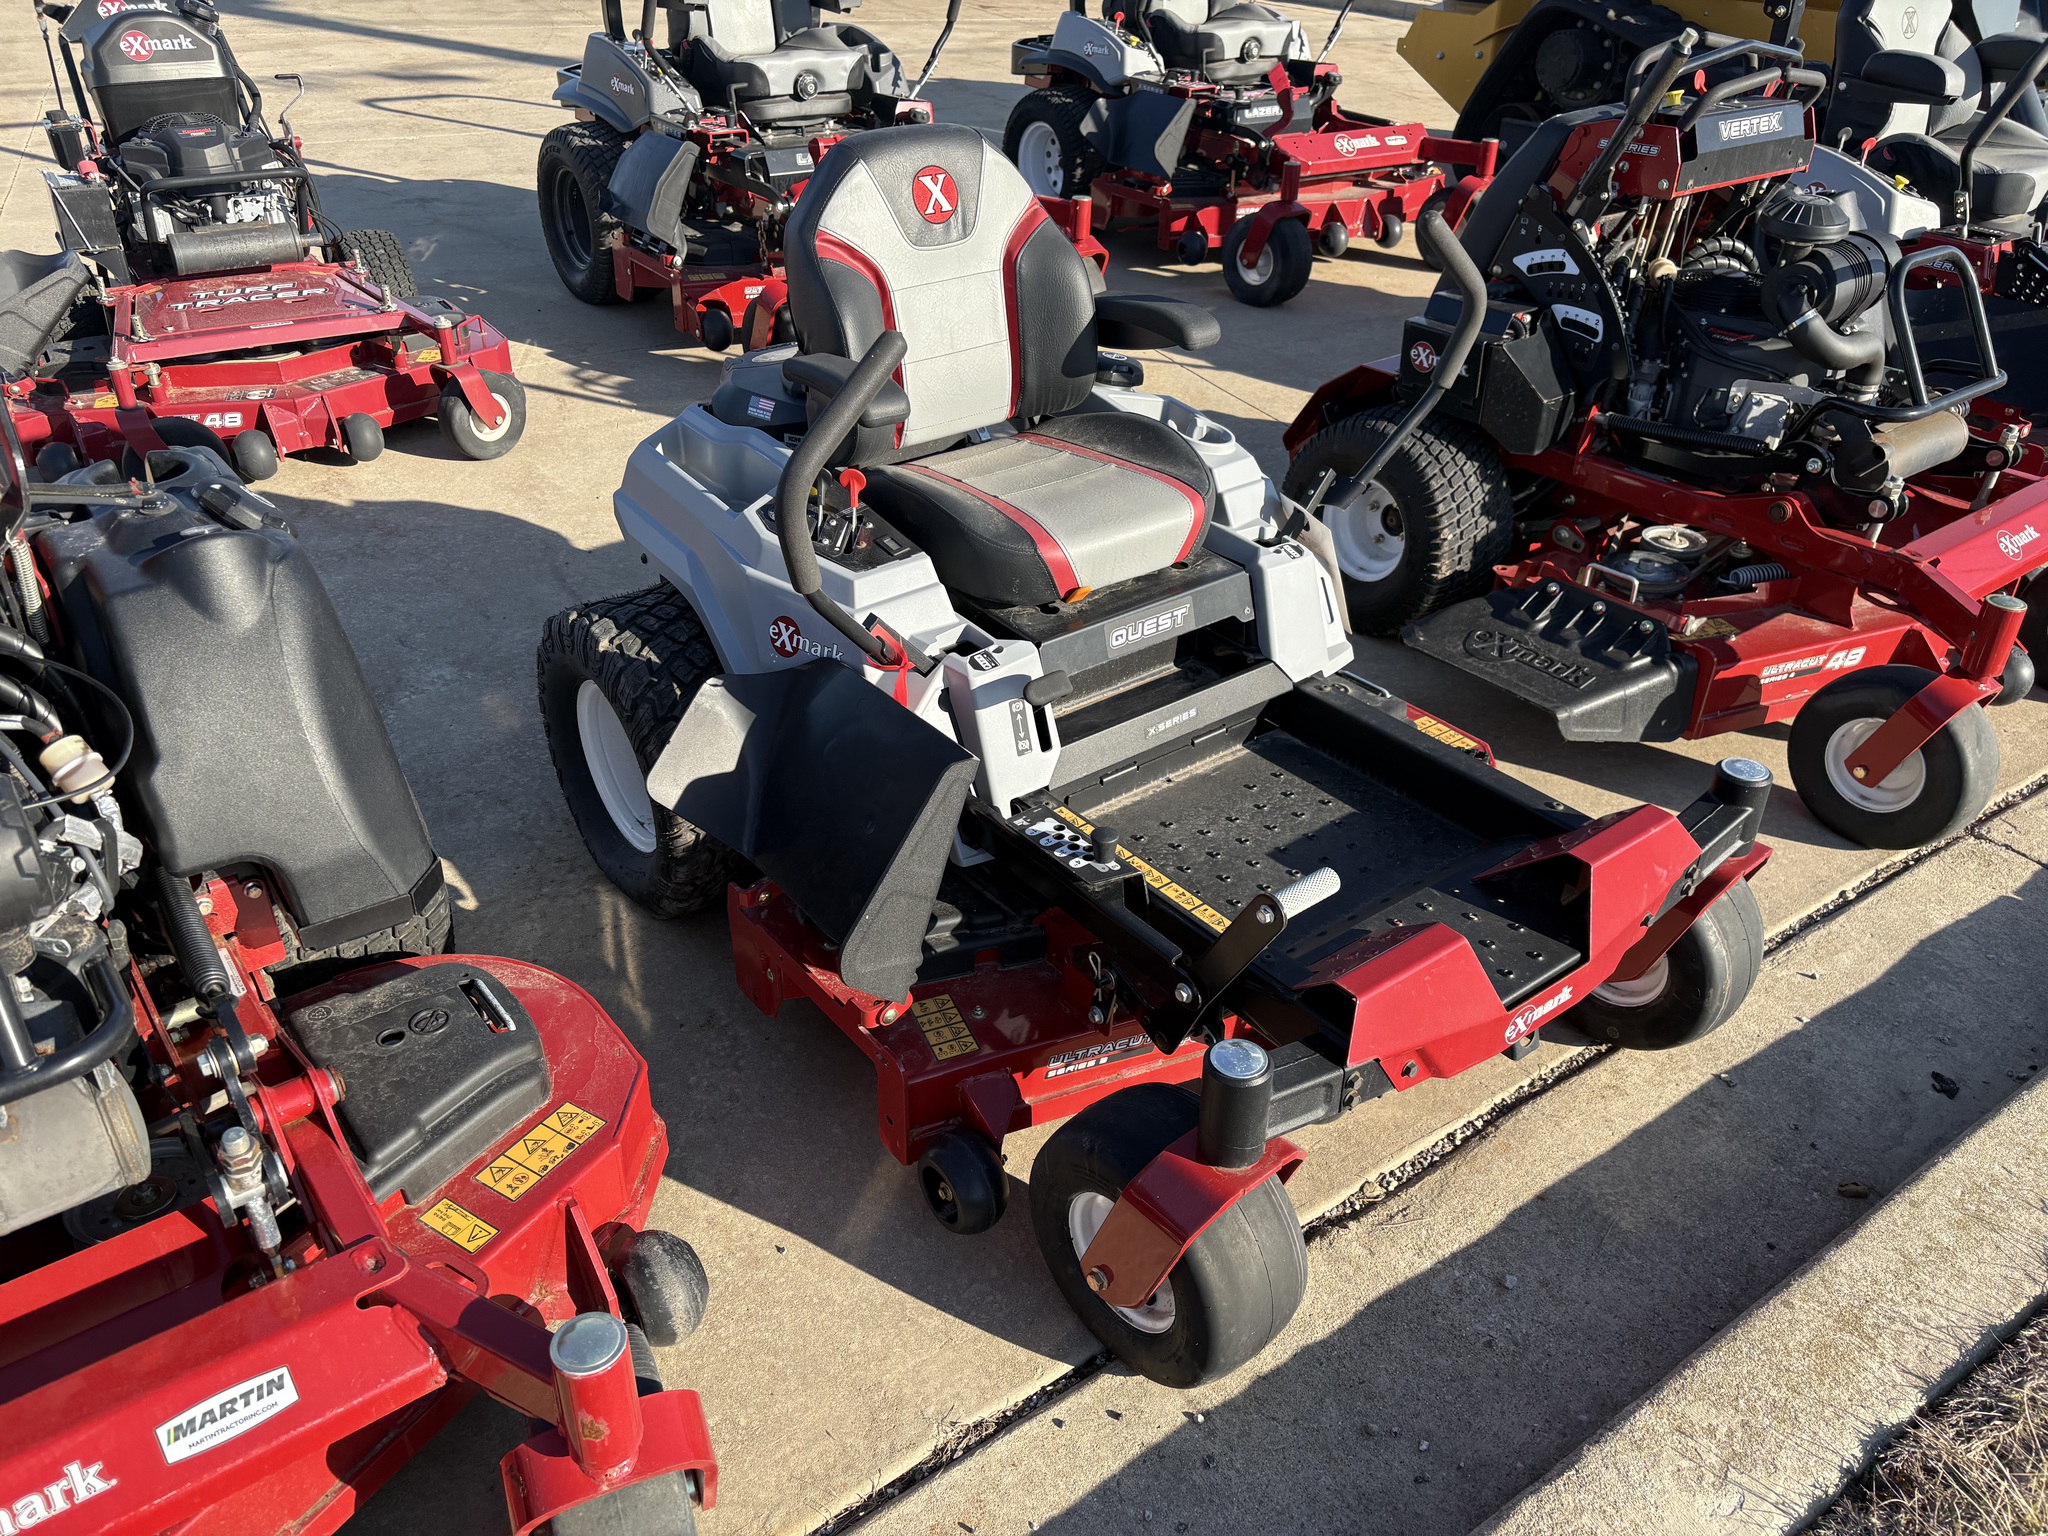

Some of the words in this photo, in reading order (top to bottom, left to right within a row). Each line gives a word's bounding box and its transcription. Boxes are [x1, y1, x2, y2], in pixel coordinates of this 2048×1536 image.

[610, 76, 635, 95] eXmark
[1718, 111, 1783, 142] VERTEX
[1334, 133, 1381, 154] eXmark
[167, 287, 329, 311] TRACER
[189, 281, 297, 299] TURF
[203, 411, 244, 429] 48
[1998, 524, 2041, 557] eXmark
[769, 620, 845, 661] eXmark
[1109, 603, 1191, 650] QUEST
[1472, 629, 1592, 684] eXmark
[1761, 654, 1829, 677] ULTRACUT
[1823, 645, 1867, 671] 48
[1506, 985, 1574, 1041] eXmark
[1047, 1060, 1097, 1078] SERIES
[173, 1372, 286, 1443] MARTIN
[188, 1400, 279, 1450] MARTINTRACTORINC.COM
